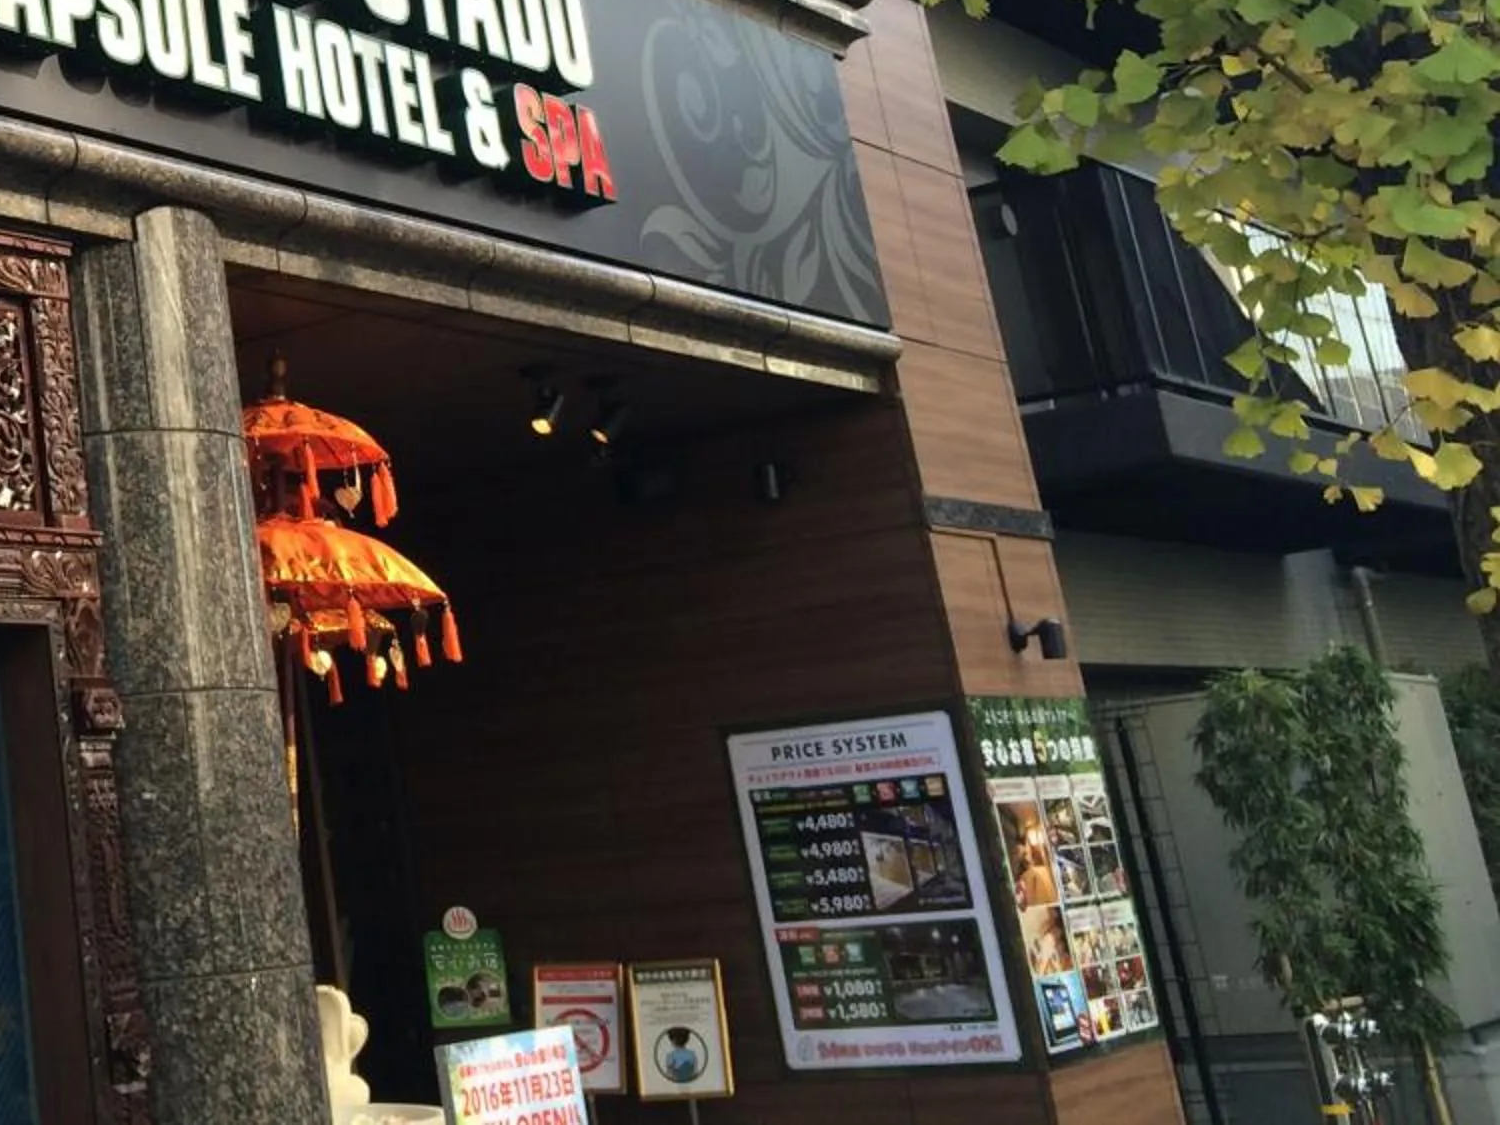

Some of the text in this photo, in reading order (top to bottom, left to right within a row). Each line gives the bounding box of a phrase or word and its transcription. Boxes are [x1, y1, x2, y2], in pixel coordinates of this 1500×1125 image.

[273, 6, 455, 157] HOTEL
[462, 70, 509, 169] &
[513, 84, 618, 203] SPA
[770, 732, 908, 762] PRICE SYSTEM
[461, 1069, 575, 1117] 2016年11月23日
